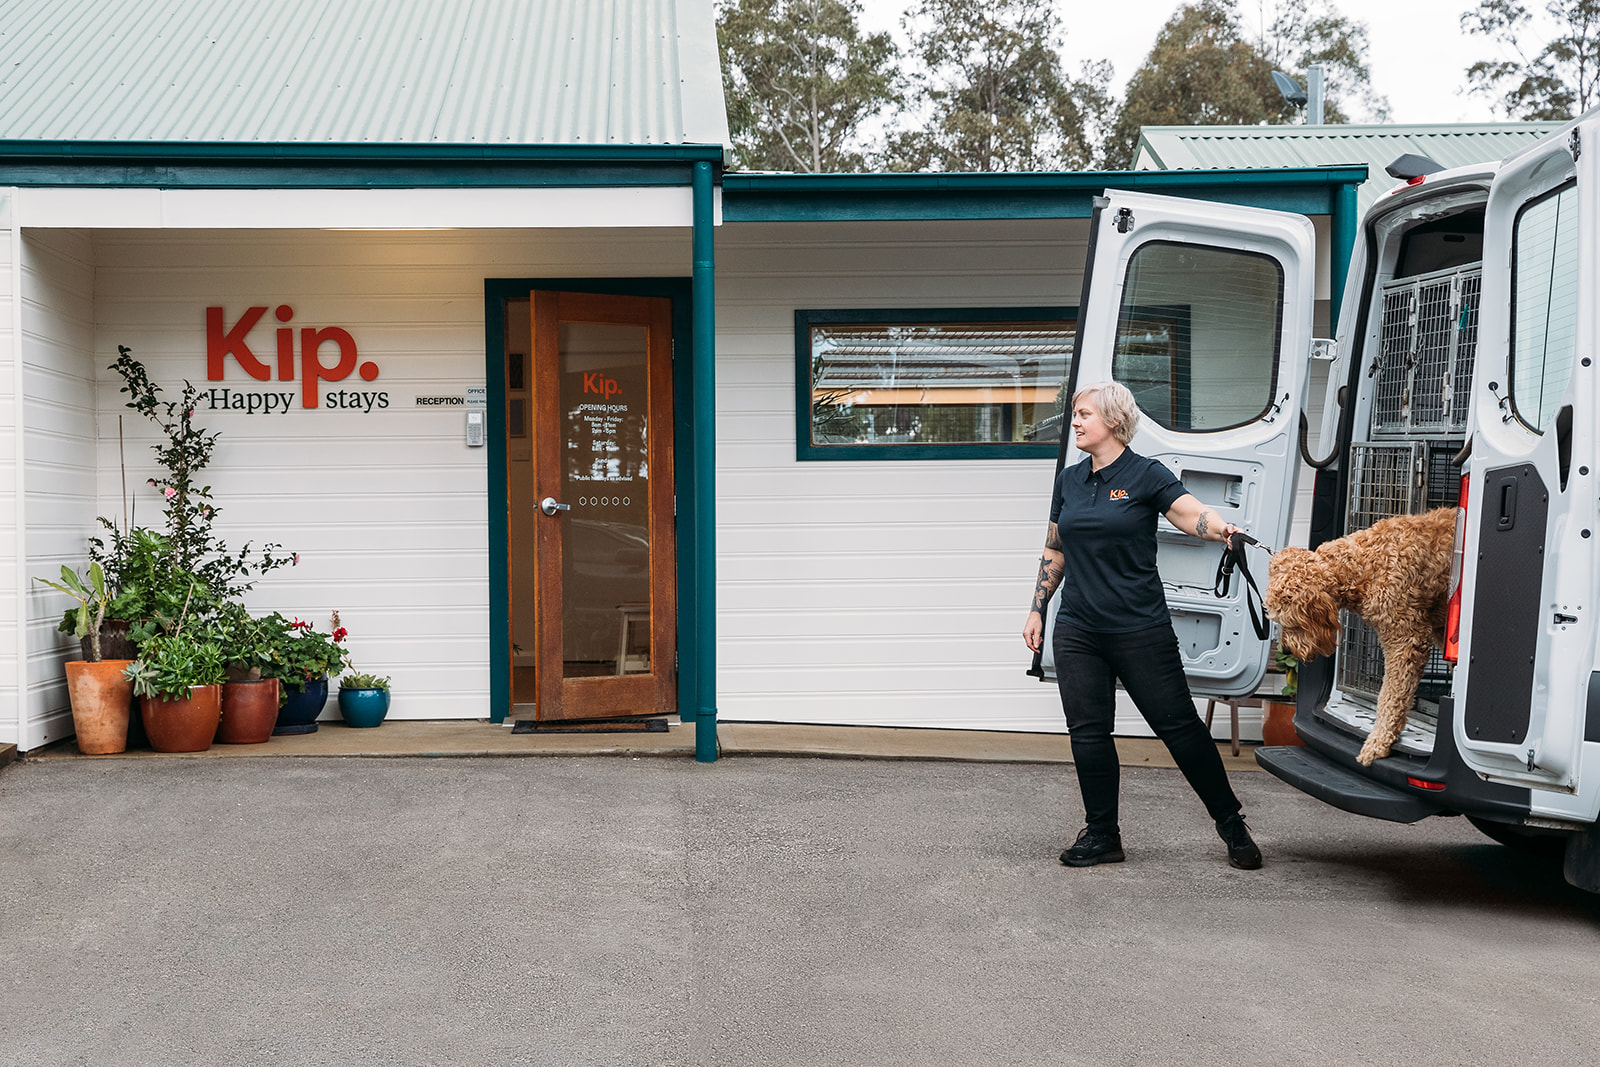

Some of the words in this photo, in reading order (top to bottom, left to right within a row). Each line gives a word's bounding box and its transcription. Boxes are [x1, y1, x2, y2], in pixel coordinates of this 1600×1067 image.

[206, 304, 380, 409] Kip.
[583, 372, 623, 400] Kip.
[208, 388, 295, 415] Happy
[326, 389, 390, 414] stays
[416, 397, 464, 405] RECEPTION
[580, 403, 607, 411] OPENING
[608, 404, 628, 412] HOURS
[1110, 489, 1128, 499] Kip.
